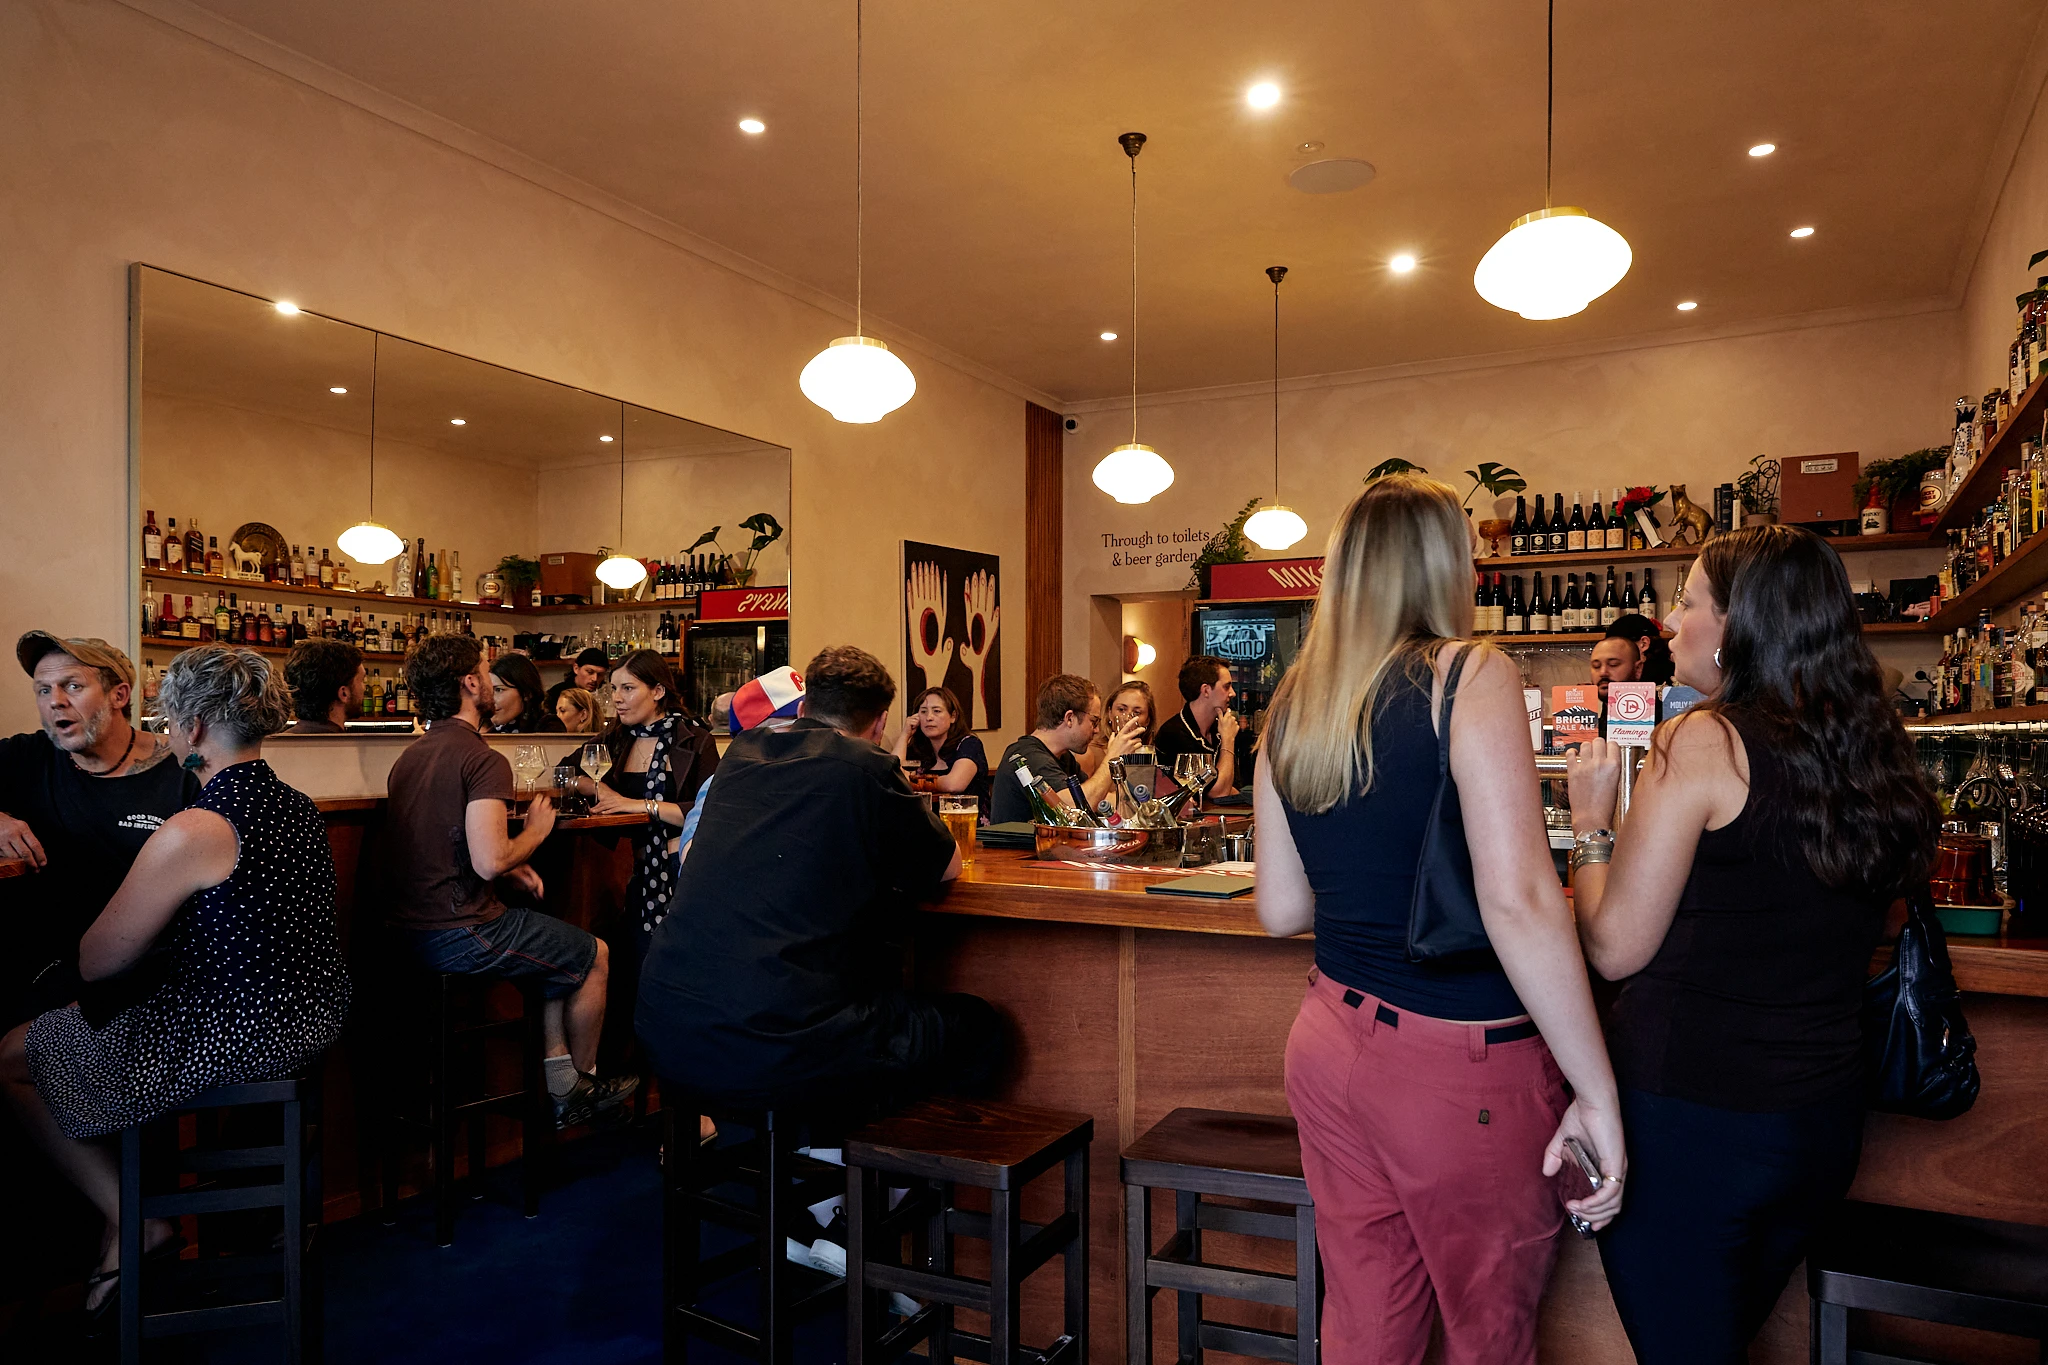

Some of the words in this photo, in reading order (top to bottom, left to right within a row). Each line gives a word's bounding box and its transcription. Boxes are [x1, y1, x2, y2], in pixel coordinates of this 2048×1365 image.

[1101, 531, 1153, 549] Through
[1156, 532, 1168, 544] to
[1172, 528, 1210, 543] toilets
[1112, 552, 1122, 566] &
[1125, 551, 1153, 566] beer
[1155, 548, 1198, 568] garden
[1555, 715, 1595, 724] BRIGHT
[1612, 727, 1649, 738] Flamingo
